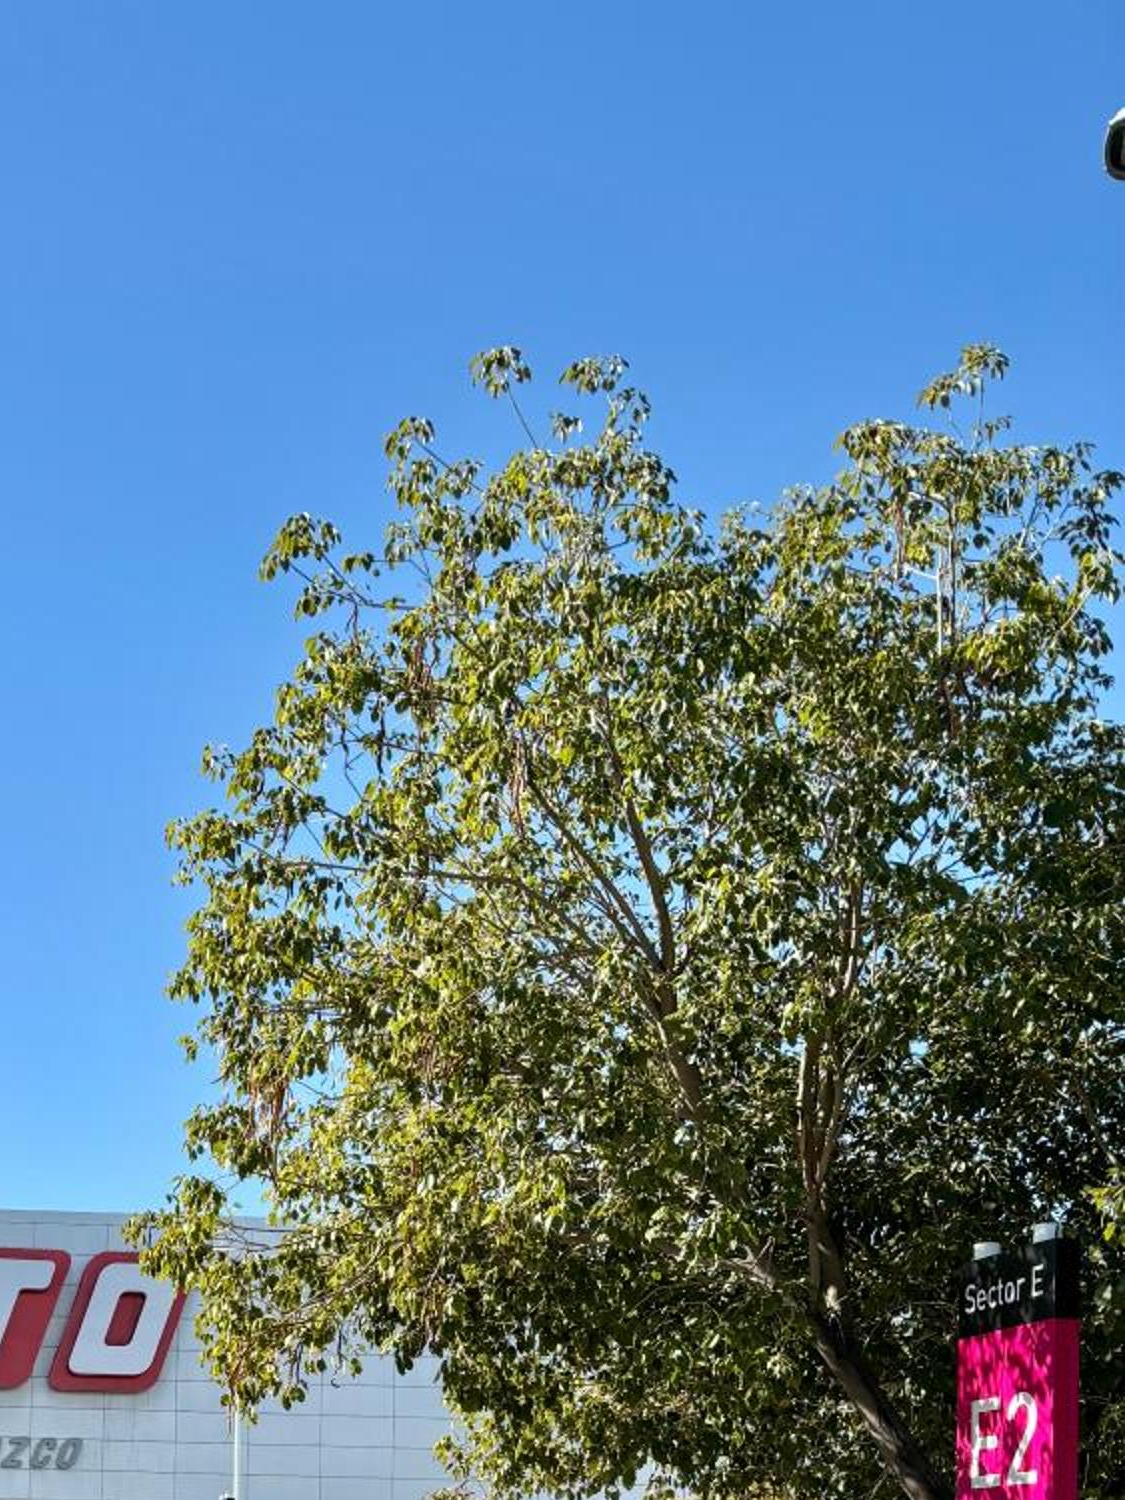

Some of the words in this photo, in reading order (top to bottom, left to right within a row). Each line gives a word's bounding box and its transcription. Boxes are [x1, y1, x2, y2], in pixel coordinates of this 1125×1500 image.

[964, 1277, 1026, 1314] Sector
[1031, 1264, 1044, 1298] E
[970, 1391, 1038, 1489] E2
